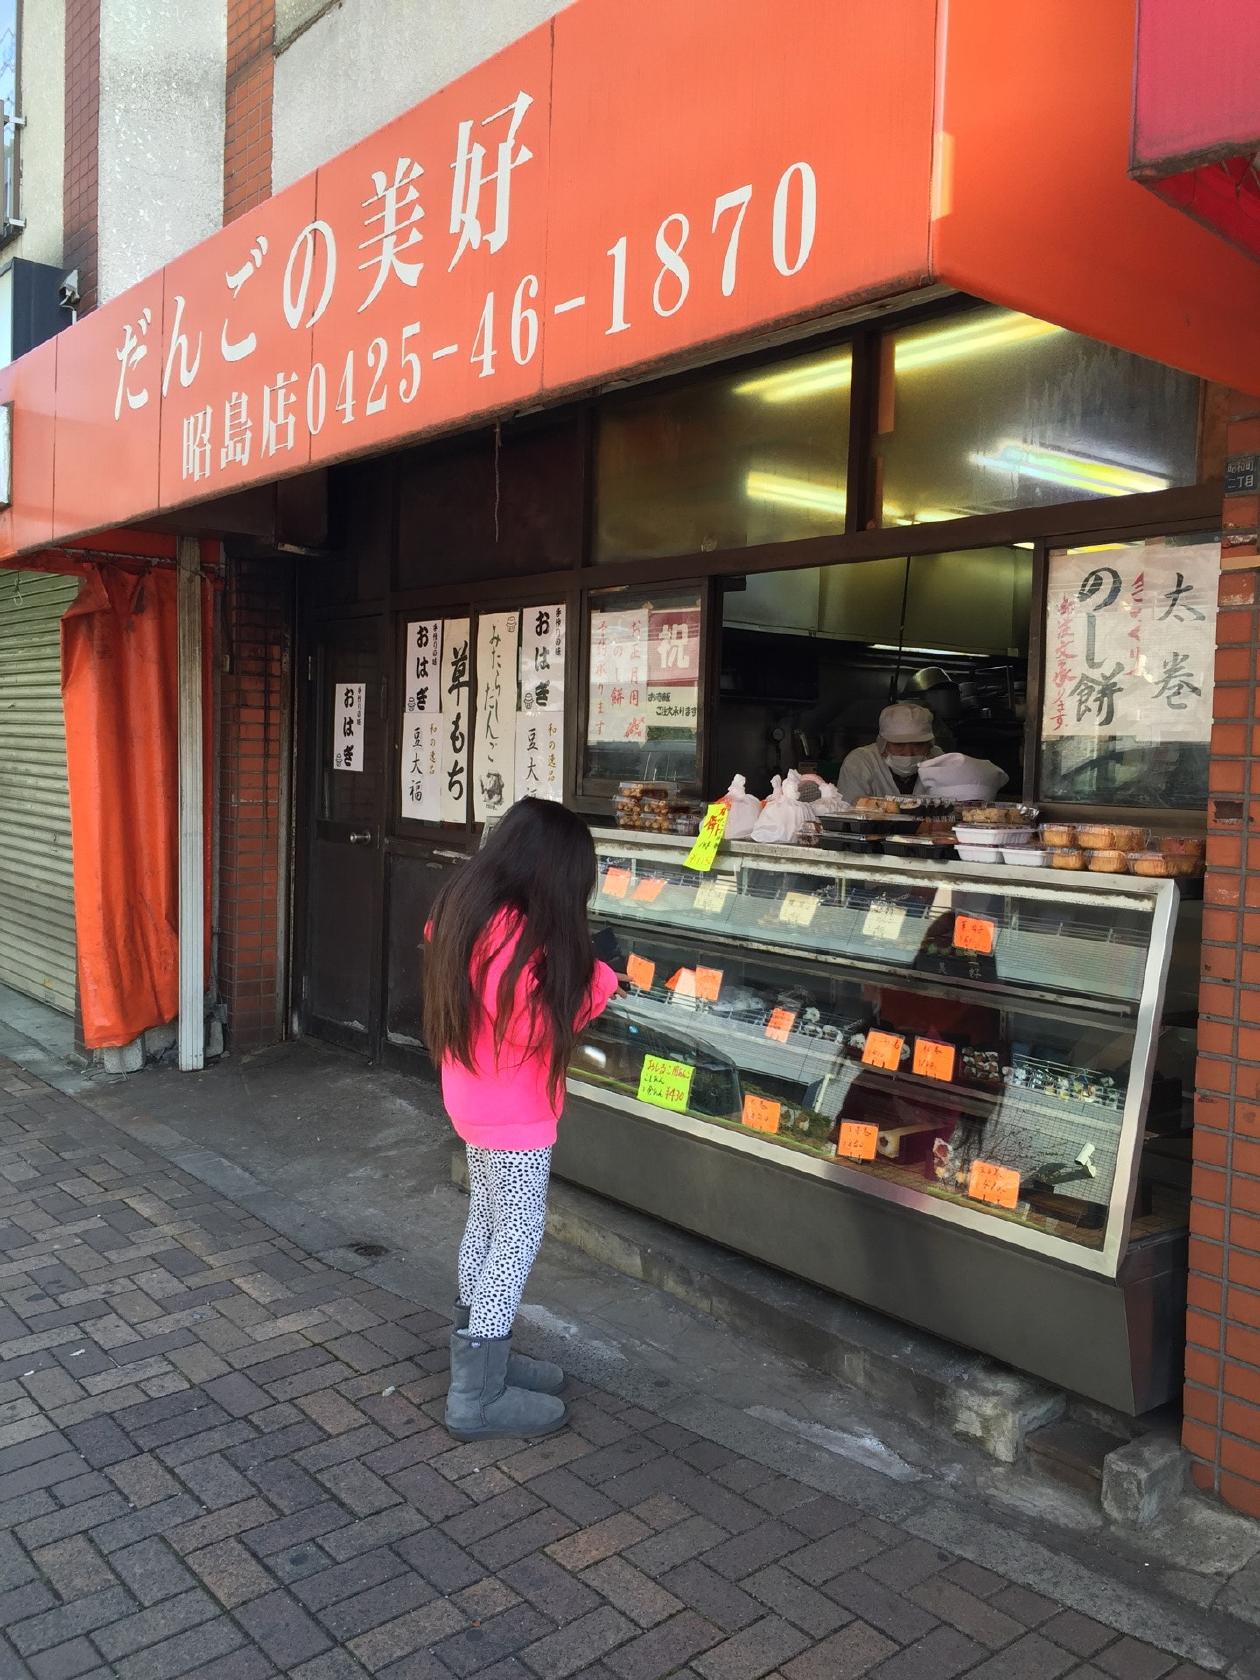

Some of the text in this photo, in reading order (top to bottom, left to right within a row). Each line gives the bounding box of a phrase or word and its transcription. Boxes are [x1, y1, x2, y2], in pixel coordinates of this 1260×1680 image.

[113, 90, 534, 423] だんごの美好
[182, 160, 818, 483] 昭島店 0425-46-1870
[415, 624, 430, 711] おはぎ
[534, 610, 551, 707] おはぎ
[656, 623, 690, 669] 祝
[1068, 566, 1126, 727] のし餅
[1152, 571, 1206, 710] 太巻
[342, 687, 355, 767] おはぎ
[408, 727, 425, 803] 豆大福
[447, 640, 470, 801] 草もち
